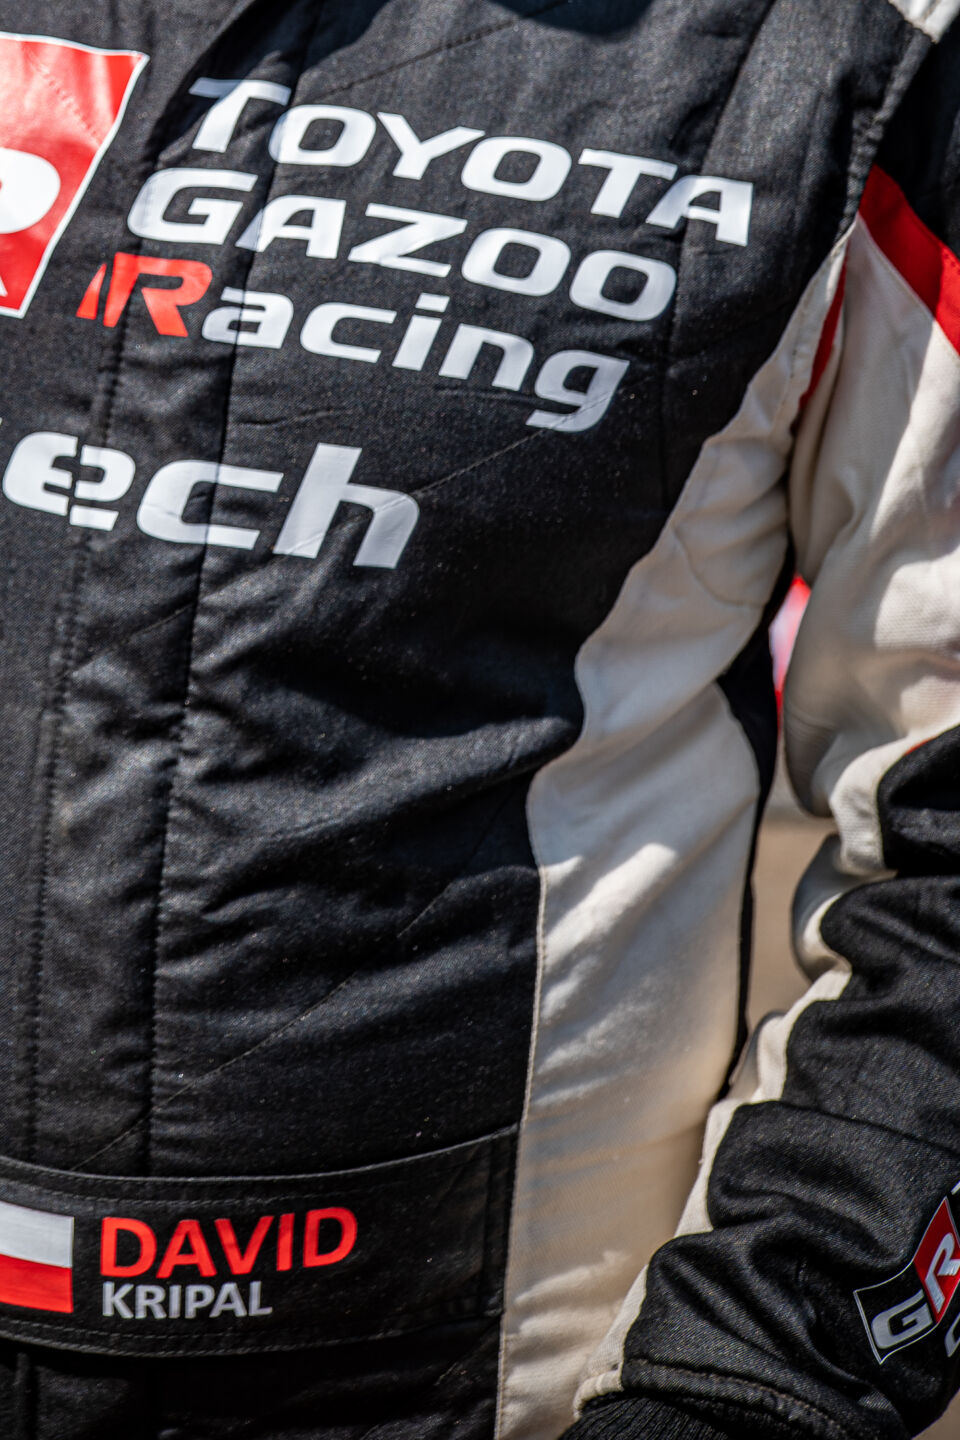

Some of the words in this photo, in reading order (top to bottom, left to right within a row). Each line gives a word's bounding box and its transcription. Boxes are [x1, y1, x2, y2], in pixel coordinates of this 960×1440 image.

[187, 77, 754, 248] TOYOTA
[125, 167, 678, 323] GAZOO
[76, 251, 631, 434] Racing
[99, 1206, 359, 1279] DAVID
[101, 1279, 273, 1320] KRIPAL
